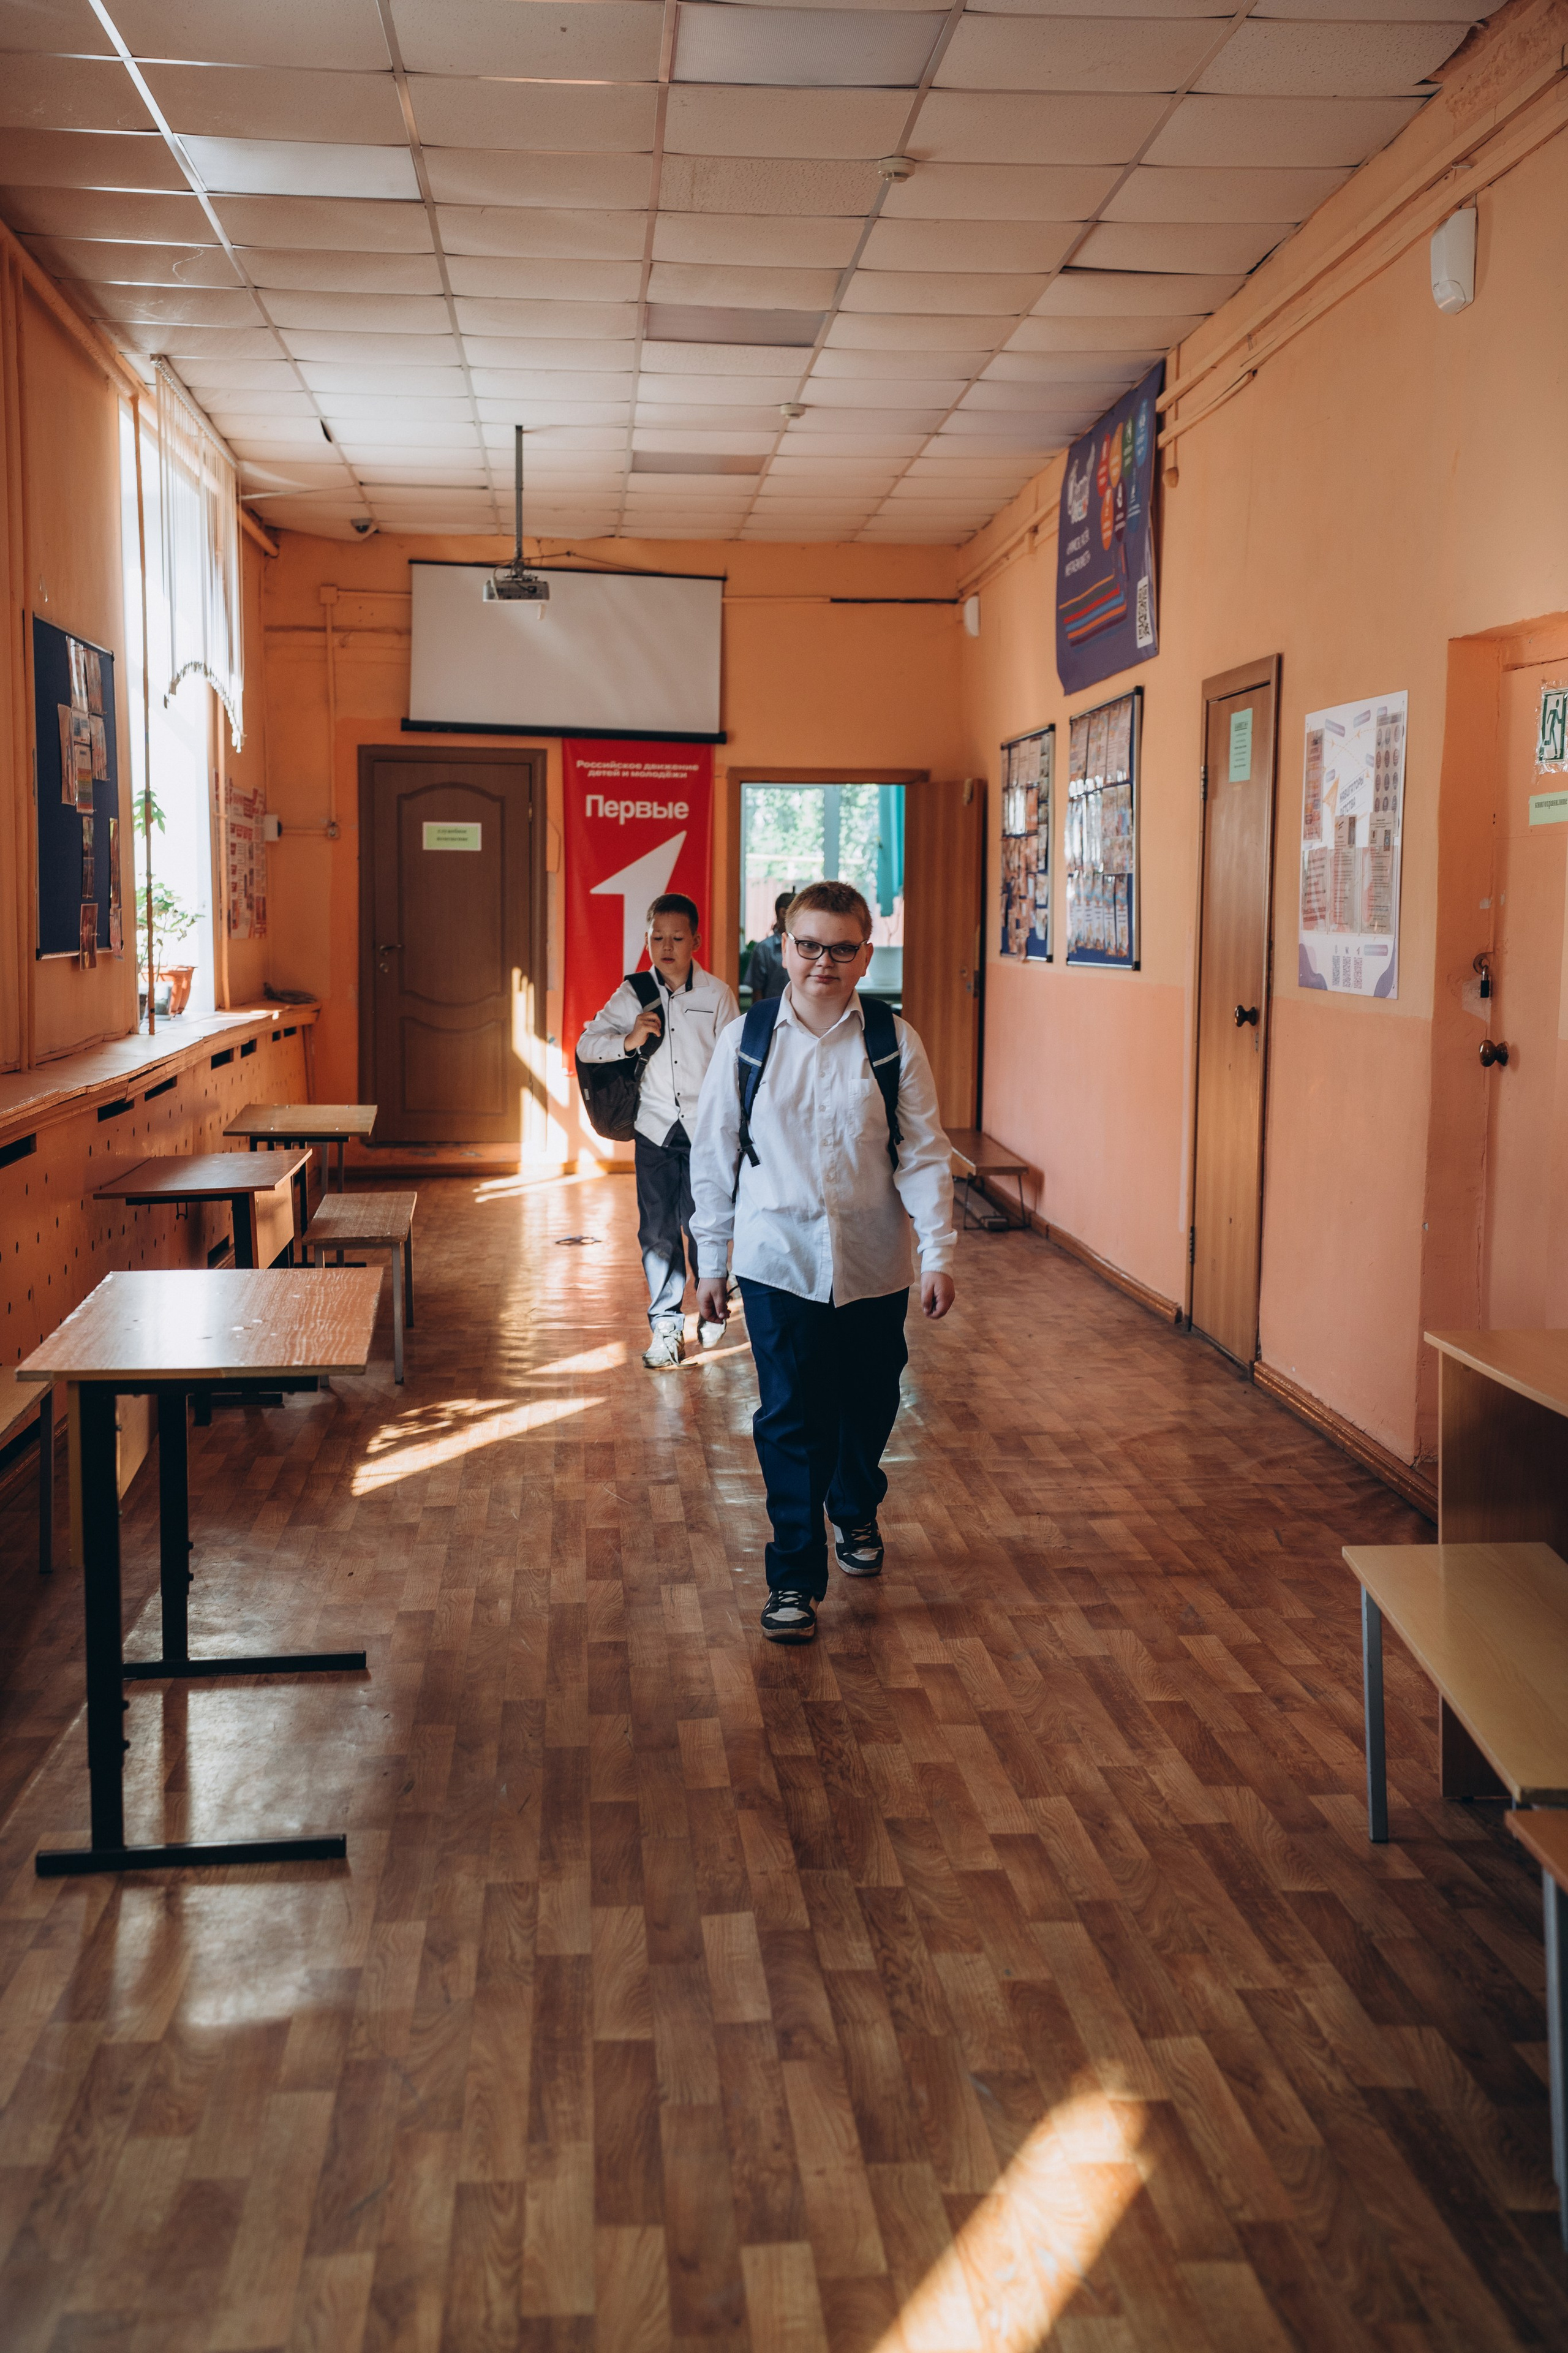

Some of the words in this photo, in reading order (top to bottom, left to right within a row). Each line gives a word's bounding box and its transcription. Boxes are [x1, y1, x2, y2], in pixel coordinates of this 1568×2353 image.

[576, 760, 642, 769] Российское
[630, 770, 687, 779] молодёжи
[586, 795, 689, 825] Первые
